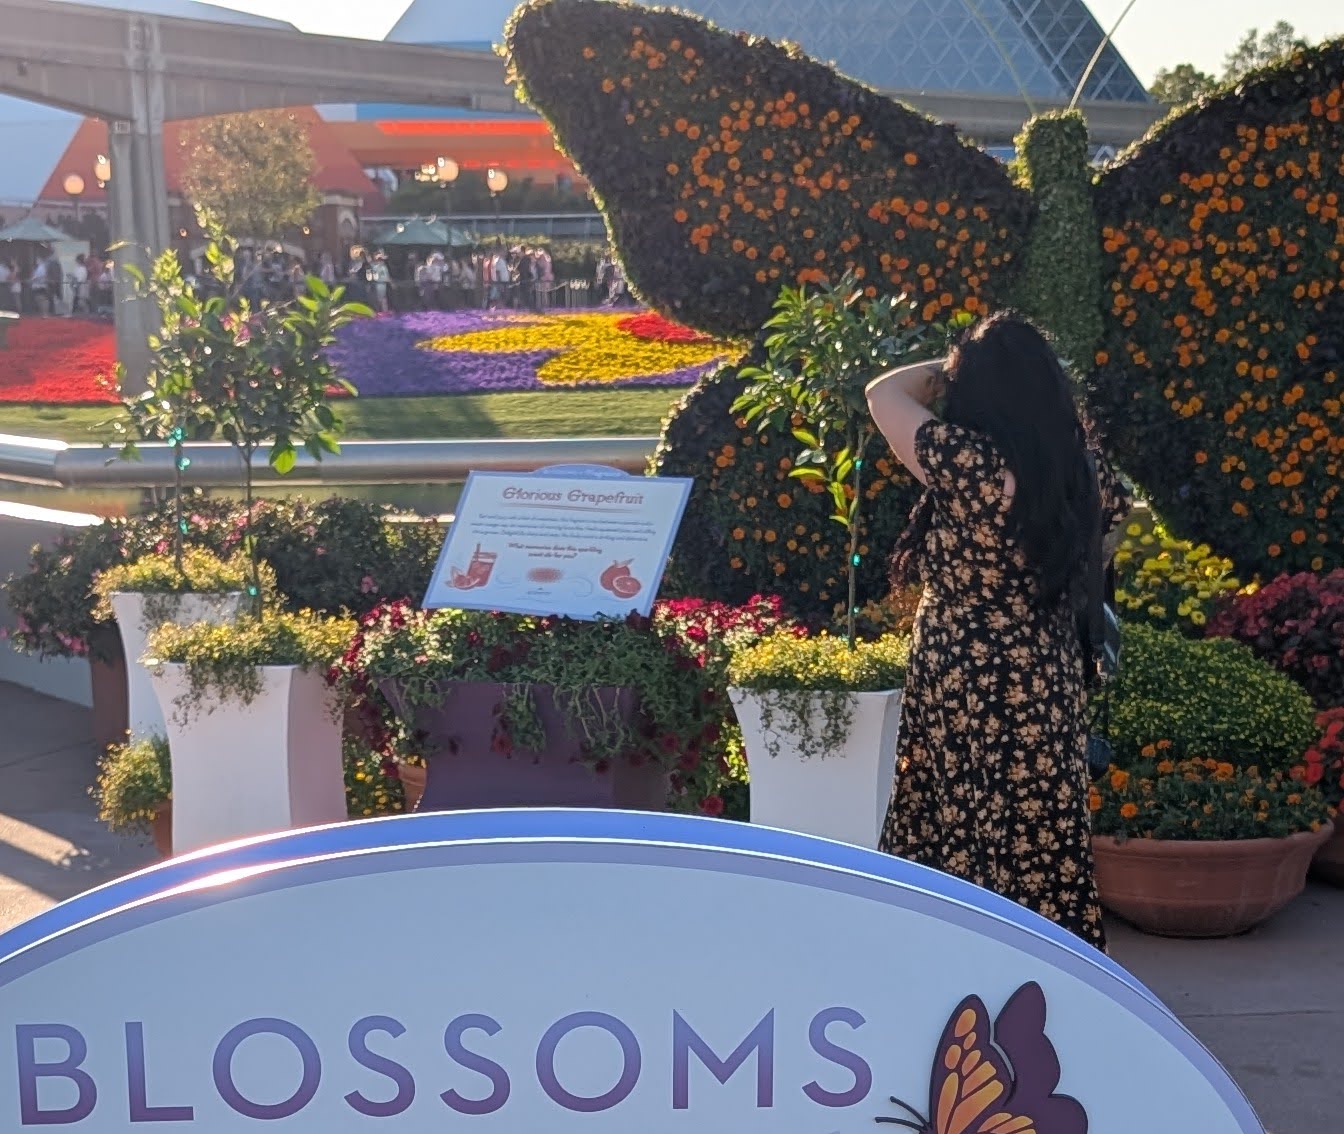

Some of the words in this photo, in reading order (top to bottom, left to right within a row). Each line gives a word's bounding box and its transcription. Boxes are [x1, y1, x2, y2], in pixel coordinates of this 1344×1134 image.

[502, 487, 562, 501] Glorious
[567, 489, 644, 505] Grapefruit
[15, 1006, 873, 1126] BLOSSOMS
